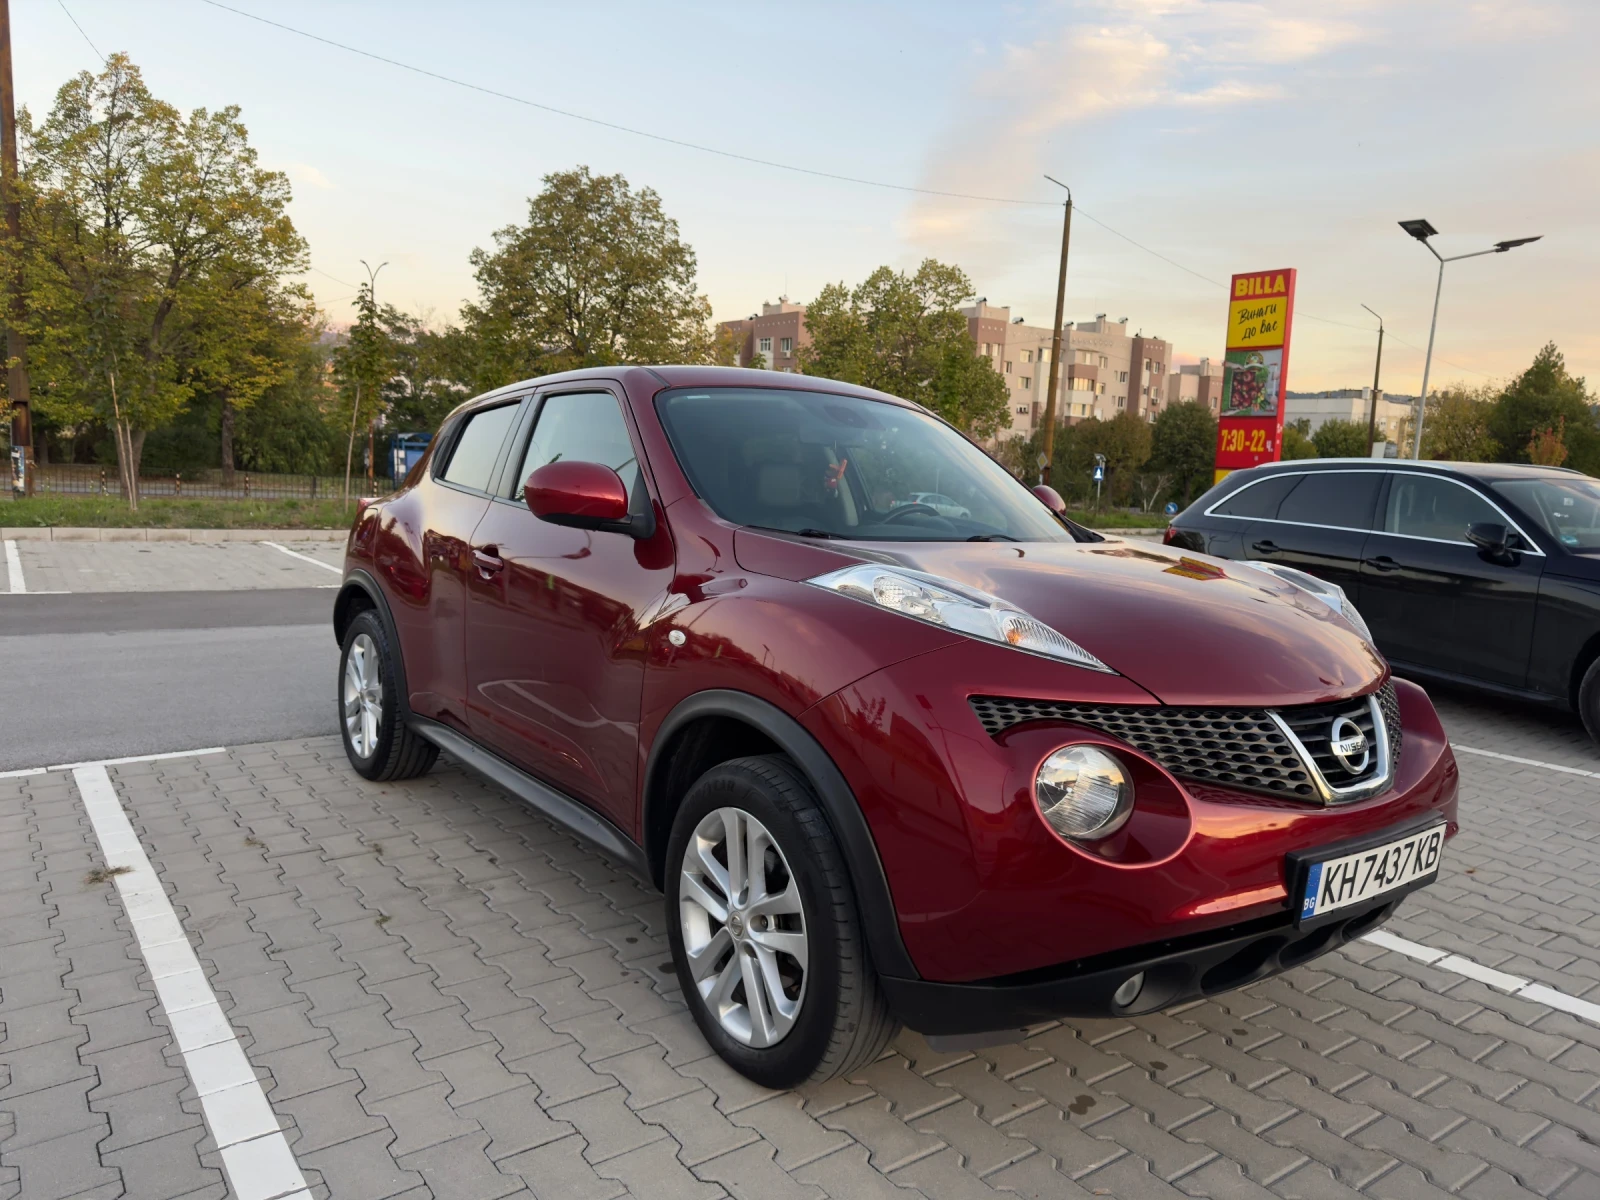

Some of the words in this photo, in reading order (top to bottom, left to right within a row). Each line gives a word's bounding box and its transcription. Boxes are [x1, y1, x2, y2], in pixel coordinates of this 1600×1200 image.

[1234, 274, 1286, 297] BILLA
[1237, 303, 1277, 325] Винаги
[1339, 740, 1369, 753] NISSA
[1303, 896, 1316, 911] BG
